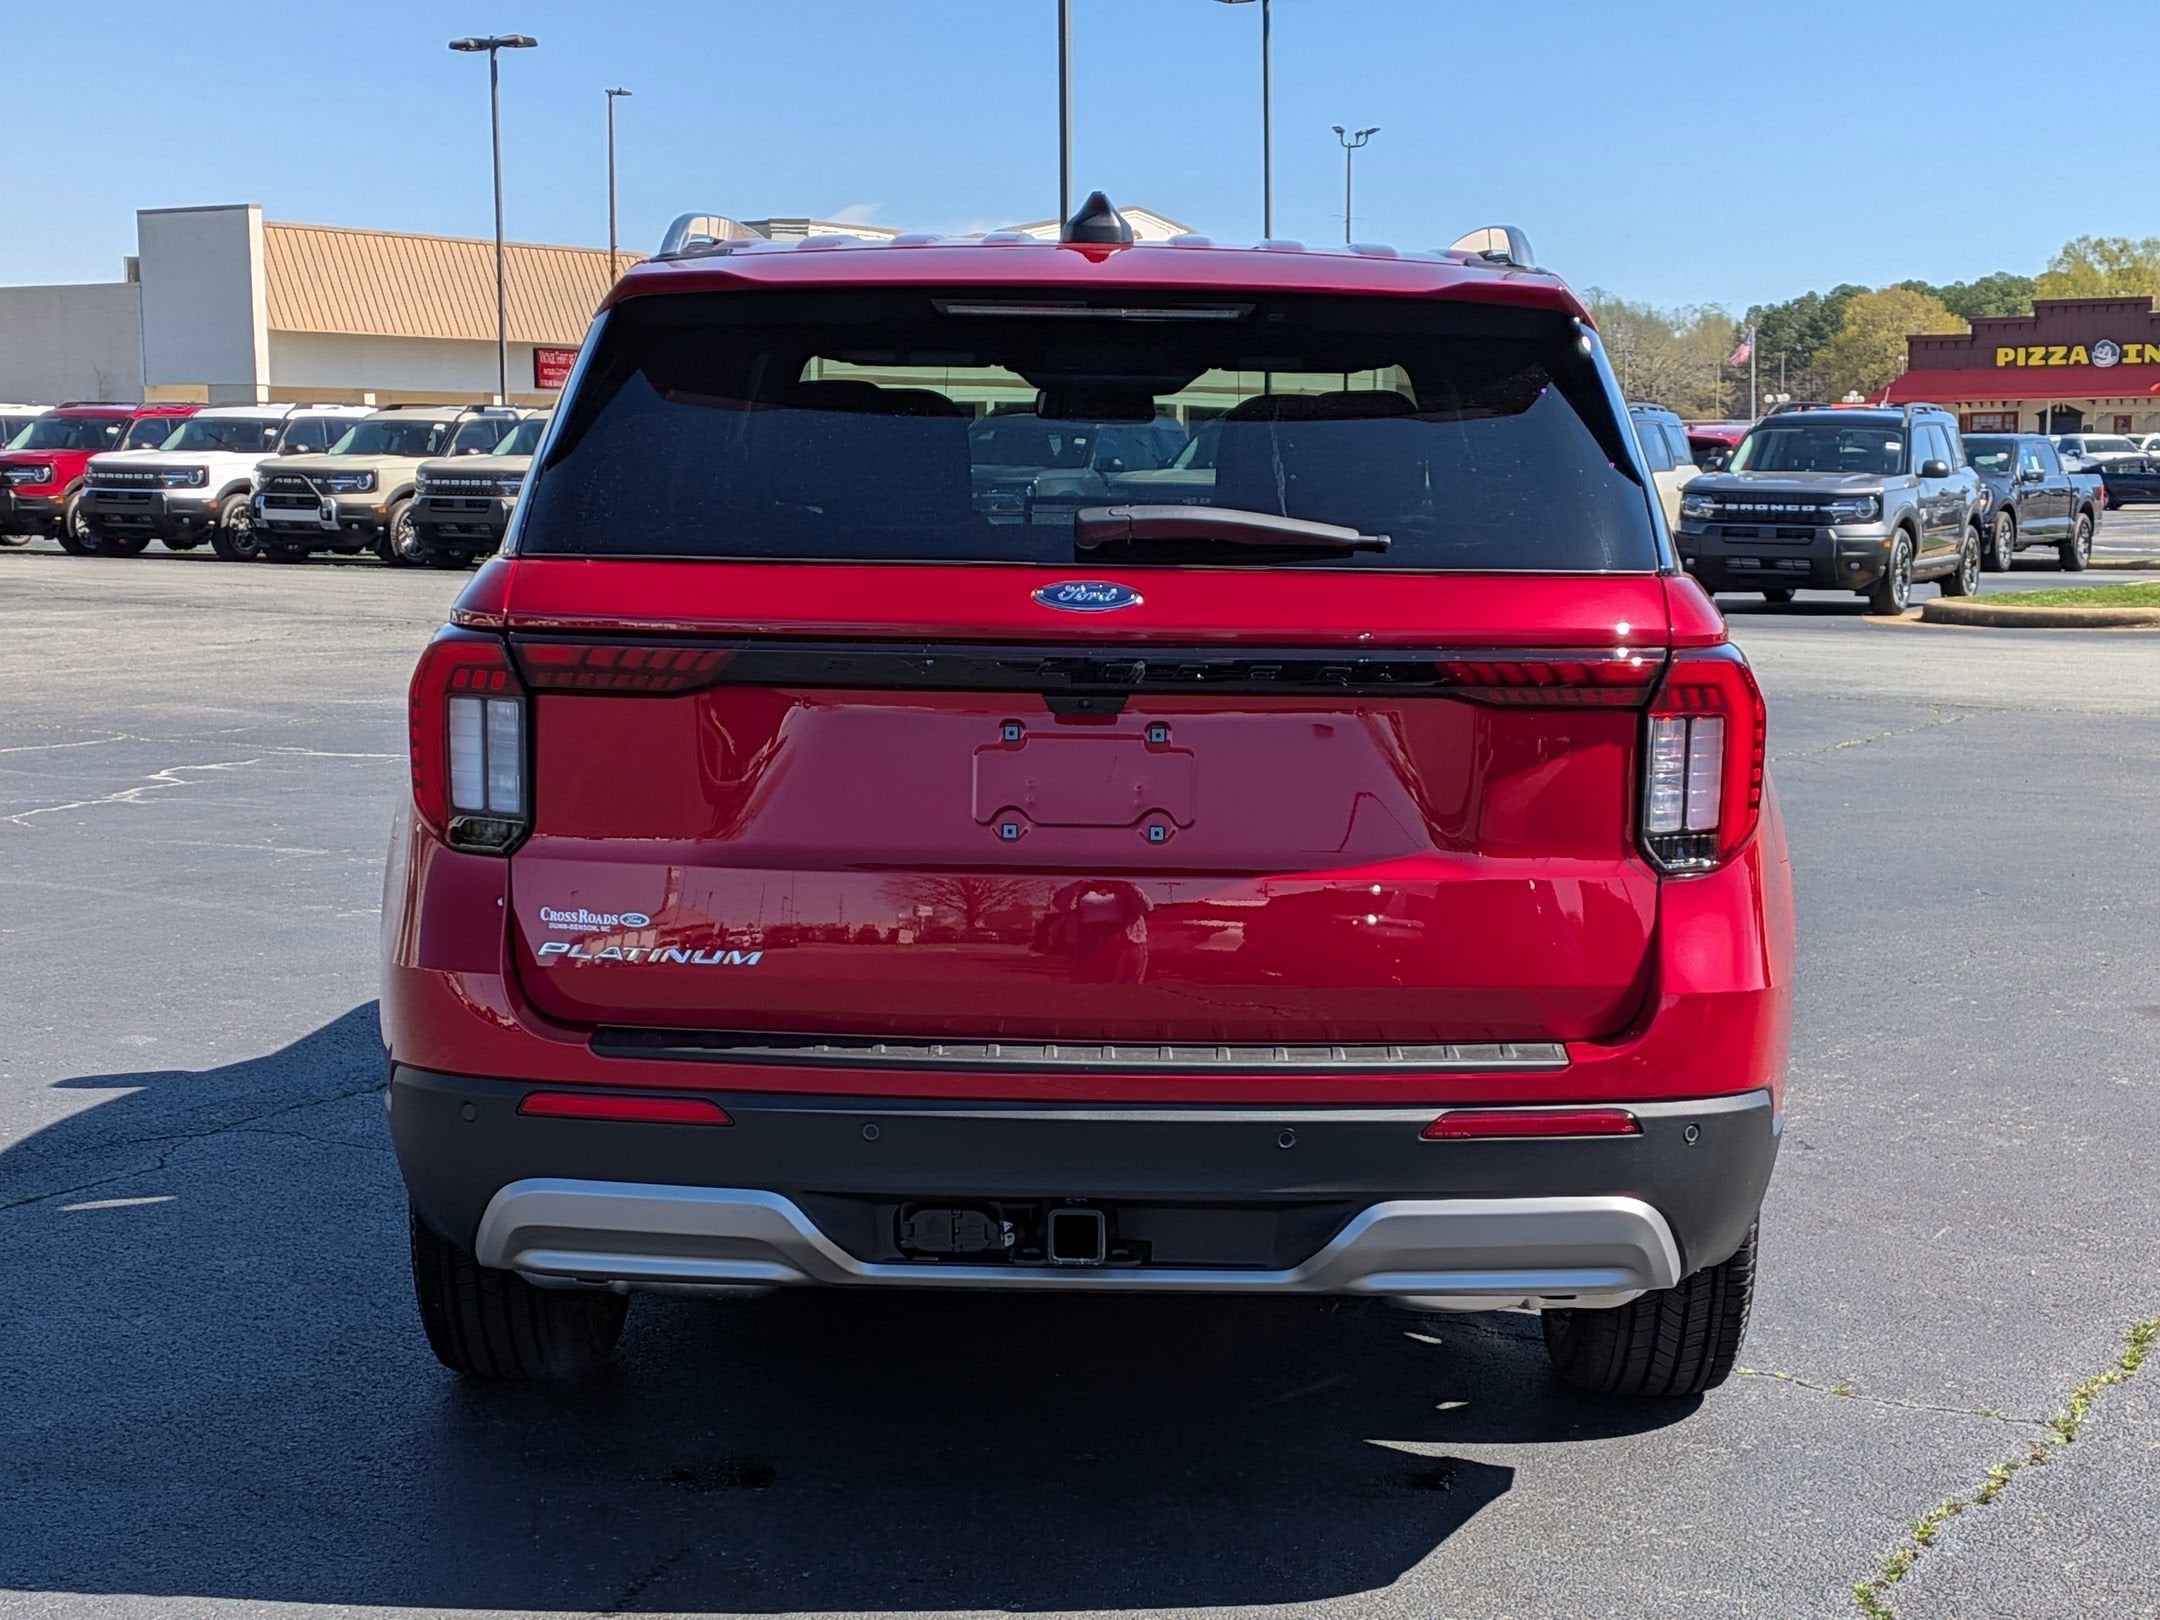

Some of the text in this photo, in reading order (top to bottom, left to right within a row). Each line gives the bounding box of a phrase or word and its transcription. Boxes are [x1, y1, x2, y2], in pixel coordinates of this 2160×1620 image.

[1996, 345, 2089, 367] PIZZA
[1725, 503, 1816, 511] BRONCO
[537, 942, 764, 966] PLATINUM
